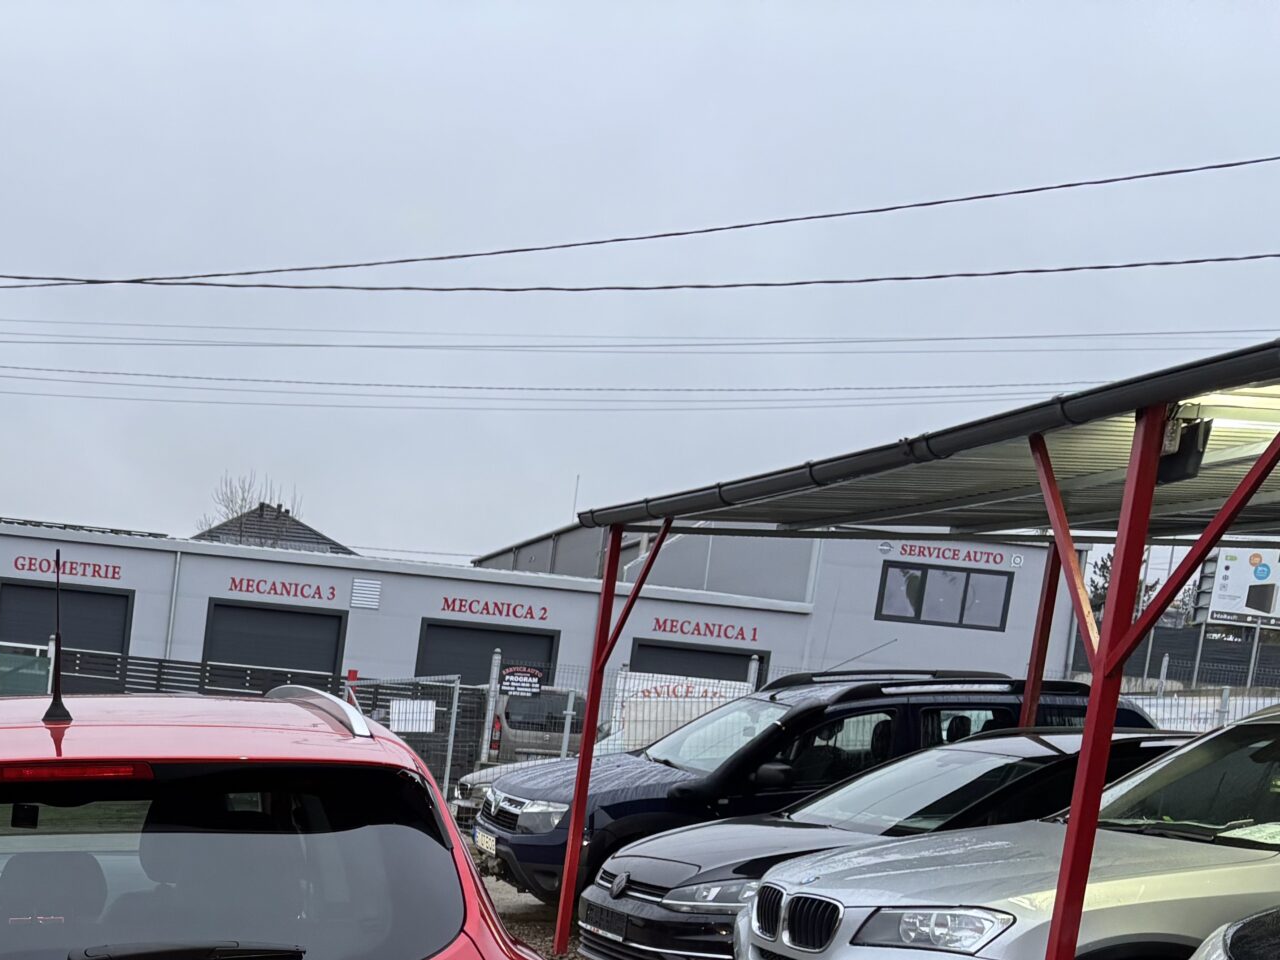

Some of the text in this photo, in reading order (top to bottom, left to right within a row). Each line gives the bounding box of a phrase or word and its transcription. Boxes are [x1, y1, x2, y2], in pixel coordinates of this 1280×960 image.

[899, 544, 1004, 565] SERVICE AUTO
[14, 556, 121, 579] GEOMETRIE
[229, 577, 336, 600] MECANICA 3
[441, 597, 548, 620] MECANICA 2
[652, 617, 758, 641] MECANICA 1
[505, 675, 539, 683] PROGRAM
